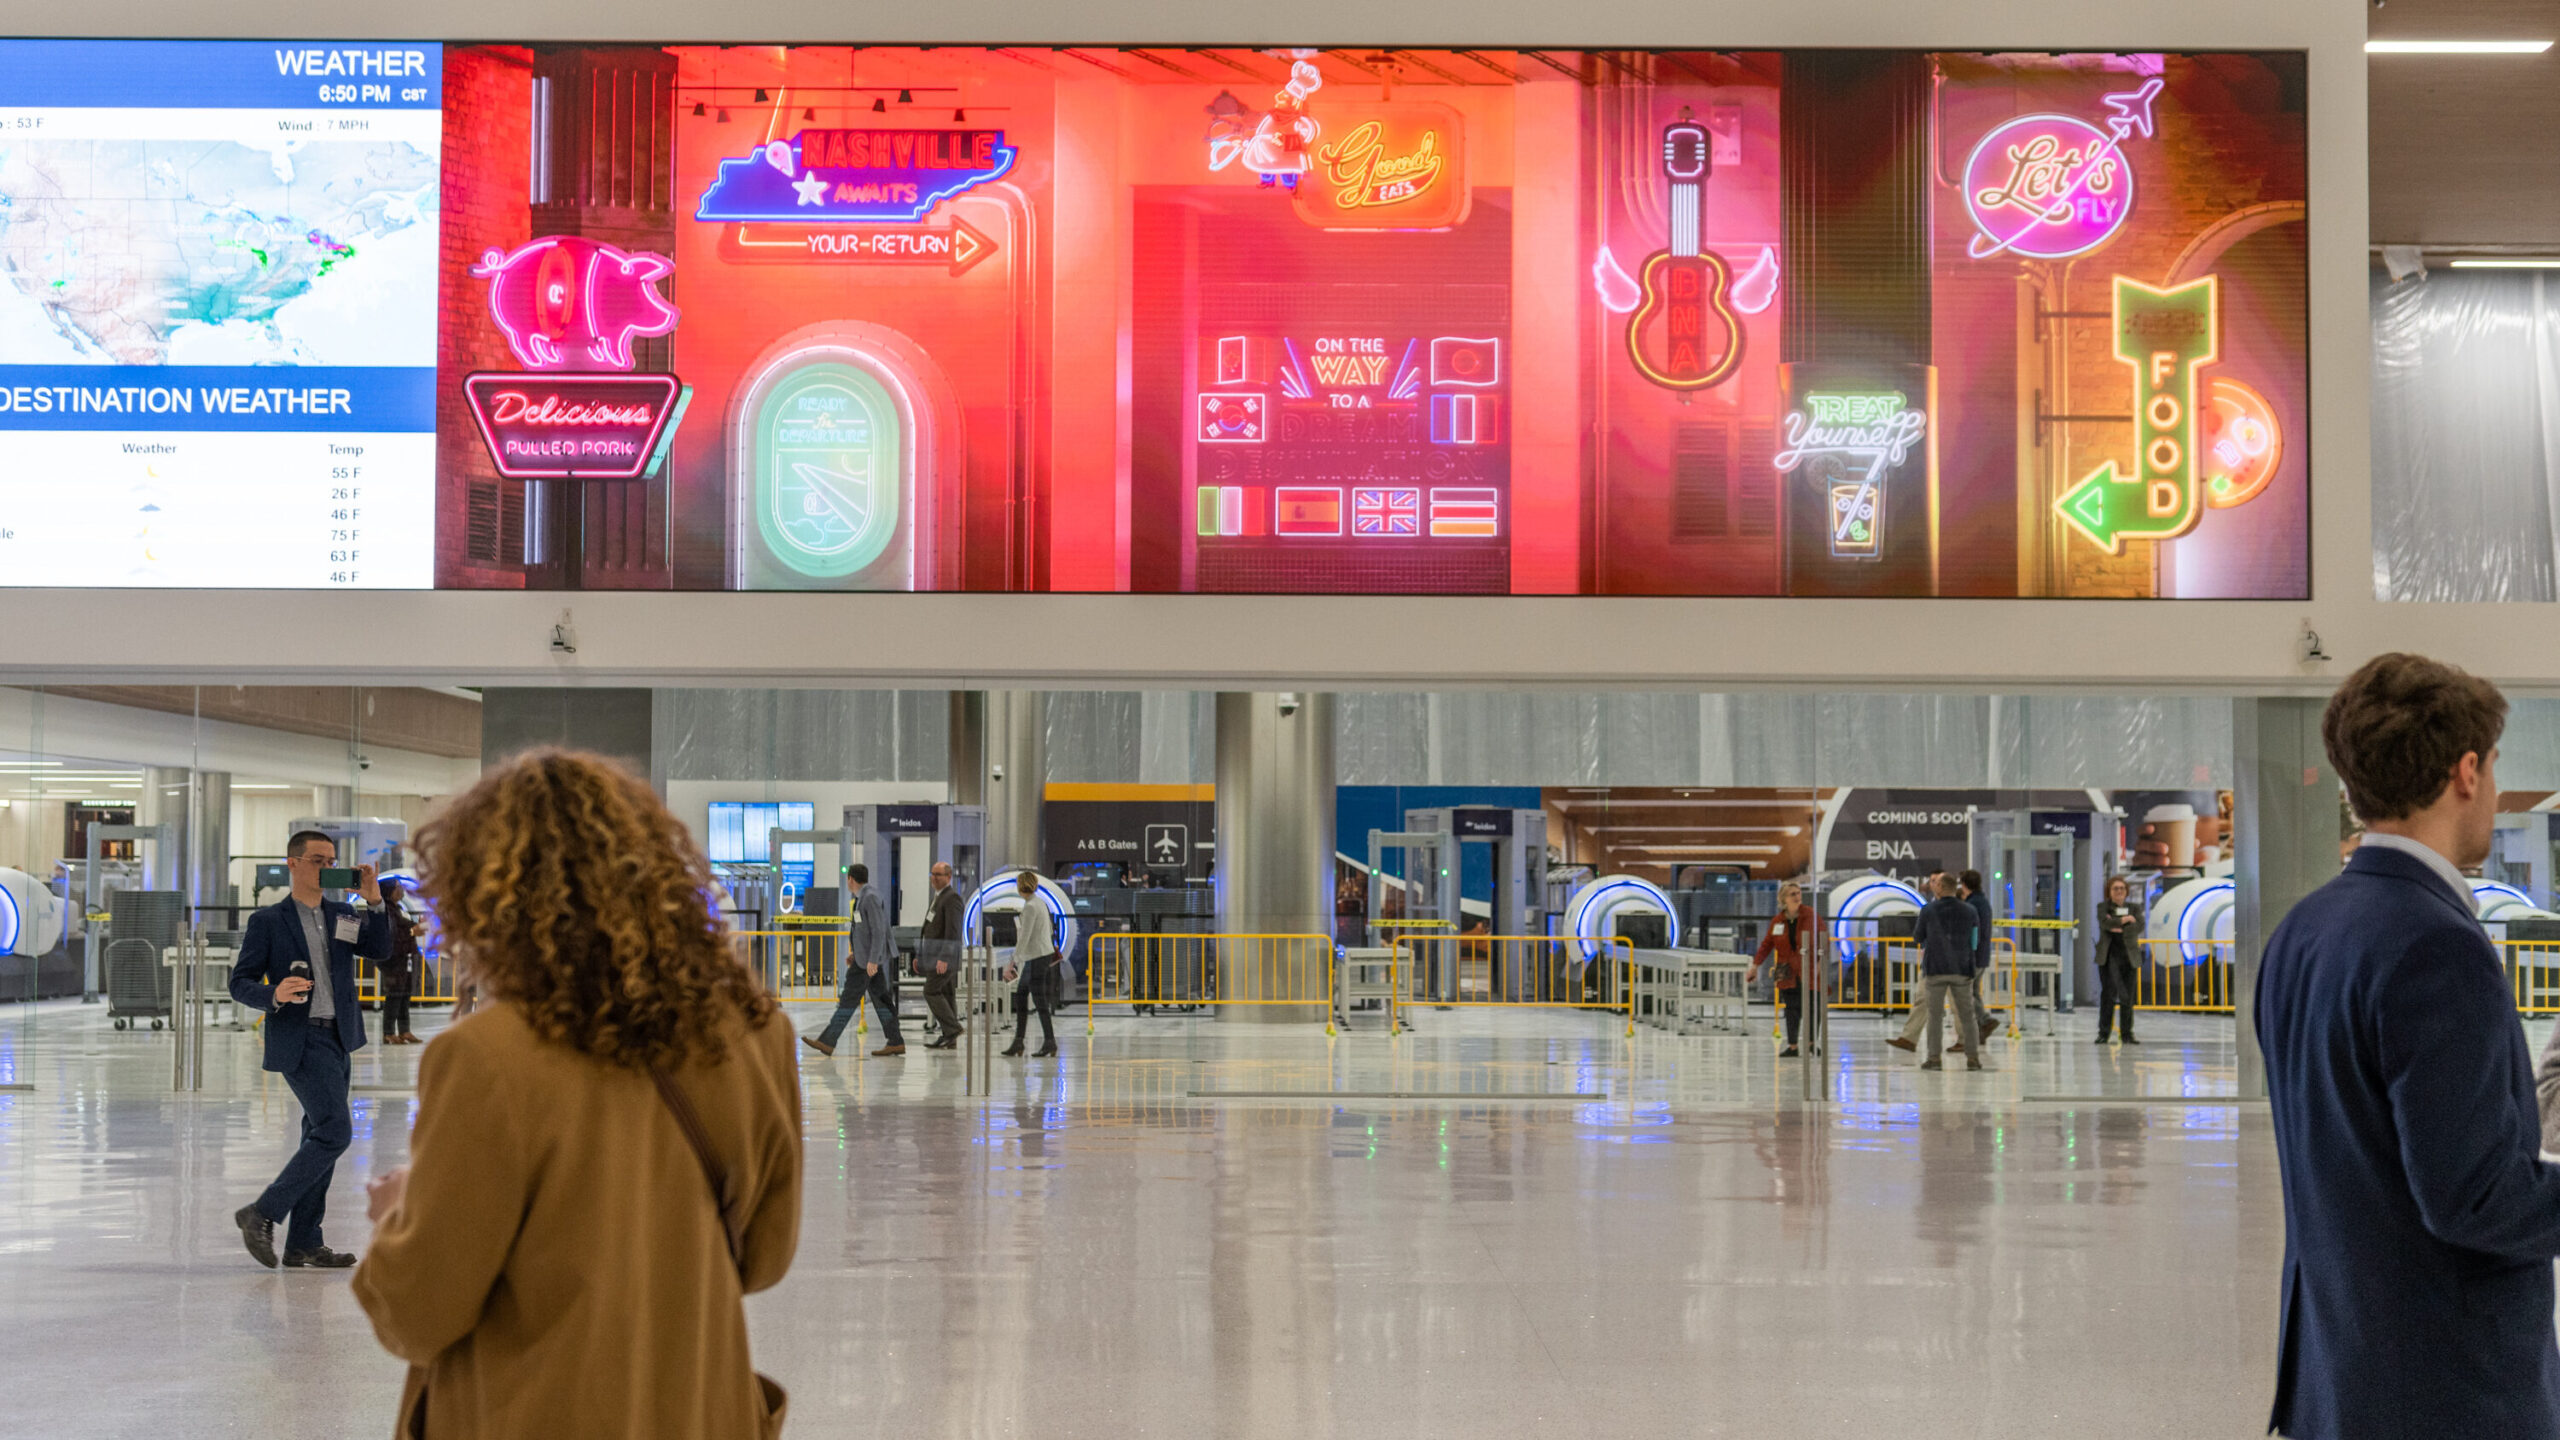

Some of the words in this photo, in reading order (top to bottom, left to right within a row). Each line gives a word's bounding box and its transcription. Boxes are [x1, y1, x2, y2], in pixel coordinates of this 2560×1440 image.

[275, 49, 426, 77] WEATHER
[319, 84, 357, 103] 6:50
[361, 85, 391, 103] PM
[401, 88, 427, 102] CST
[17, 117, 31, 128] 53
[36, 117, 45, 128] F
[327, 119, 334, 131] 7
[338, 119, 370, 131] MPH
[801, 131, 998, 170] NASHVILLE
[1318, 120, 1441, 208] Good
[1976, 134, 2117, 225] Let's
[833, 182, 919, 204] AWAITS
[1379, 181, 1416, 200] EATS
[2077, 196, 2119, 223] FLY
[1671, 266, 1700, 374] BNA
[1315, 337, 1343, 353] ON
[1348, 337, 1385, 353] THE
[1310, 355, 1390, 386] WAY
[200, 387, 353, 415] WEATHER
[492, 391, 653, 425] Delicious
[798, 396, 847, 412] READY
[1329, 393, 1353, 409] TO
[1357, 393, 1371, 409] A
[1806, 396, 1902, 423] TREAT
[779, 428, 868, 444] DEPARTURE
[1280, 412, 1419, 443] DREAM
[2146, 351, 2183, 518] FOOD
[505, 440, 576, 456] PULLED
[581, 440, 636, 457] PORK
[1773, 410, 1924, 470] Yourself
[121, 441, 178, 455] Weather
[328, 443, 365, 458] Temp
[332, 467, 348, 478] 55
[353, 467, 361, 478] F
[332, 488, 348, 499] 26
[353, 488, 361, 499] F
[331, 508, 347, 519] 46
[352, 508, 360, 519] F
[331, 529, 347, 540] 75
[352, 529, 360, 540] F
[330, 550, 346, 561] 63
[351, 550, 359, 561] F
[330, 571, 346, 582] 46
[351, 571, 359, 582] F
[899, 819, 922, 828] leidos
[1867, 811, 1928, 824] COMING
[1473, 823, 1497, 831] leidos
[2053, 824, 2076, 833] leidos
[1077, 839, 1086, 850] A
[1088, 839, 1096, 850] &
[1098, 839, 1106, 850] B
[1108, 839, 1138, 850] Gates
[1866, 840, 1916, 860] BNA
